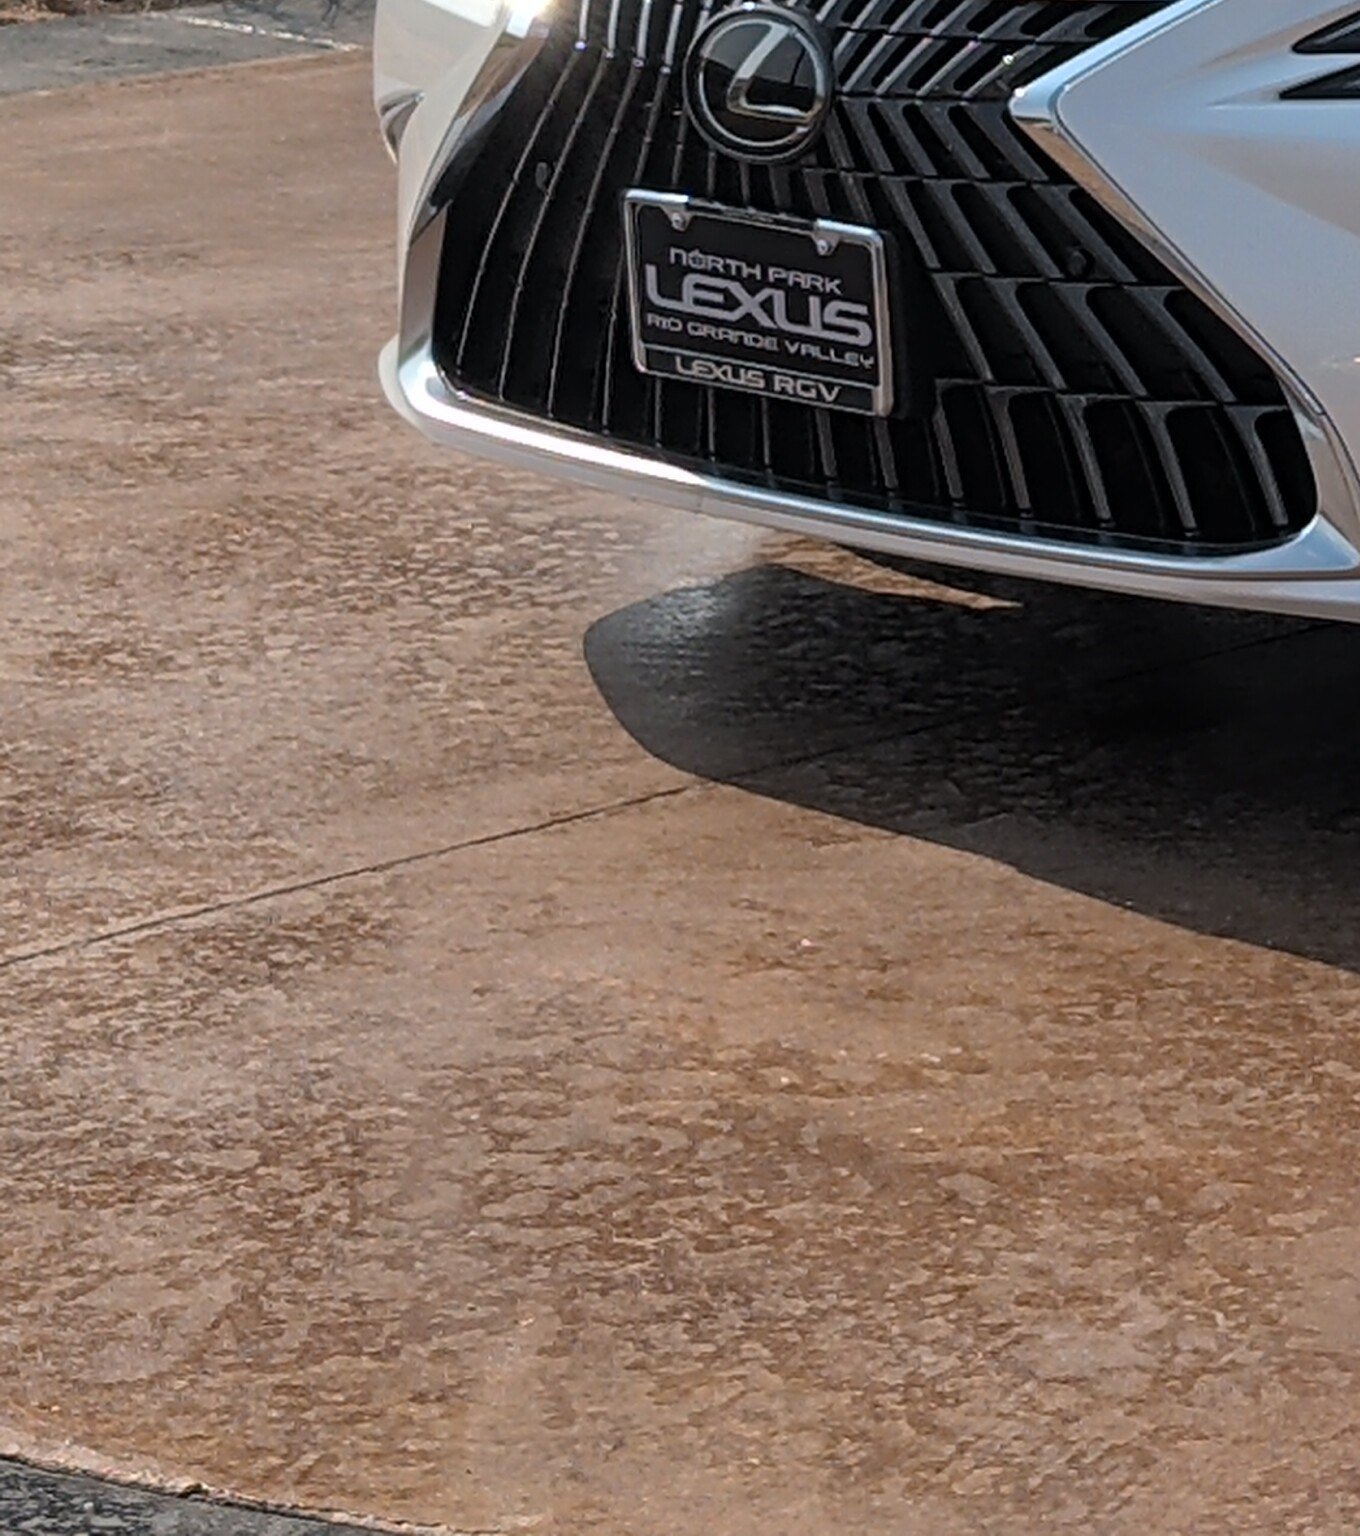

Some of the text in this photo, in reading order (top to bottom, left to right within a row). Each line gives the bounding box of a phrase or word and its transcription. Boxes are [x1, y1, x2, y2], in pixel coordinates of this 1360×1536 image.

[669, 246, 843, 296] NORTH PARK
[645, 263, 874, 348] LEXUS
[646, 313, 875, 370] RIO GRANDE VALLEY
[675, 355, 842, 403] LEXUS RGV
